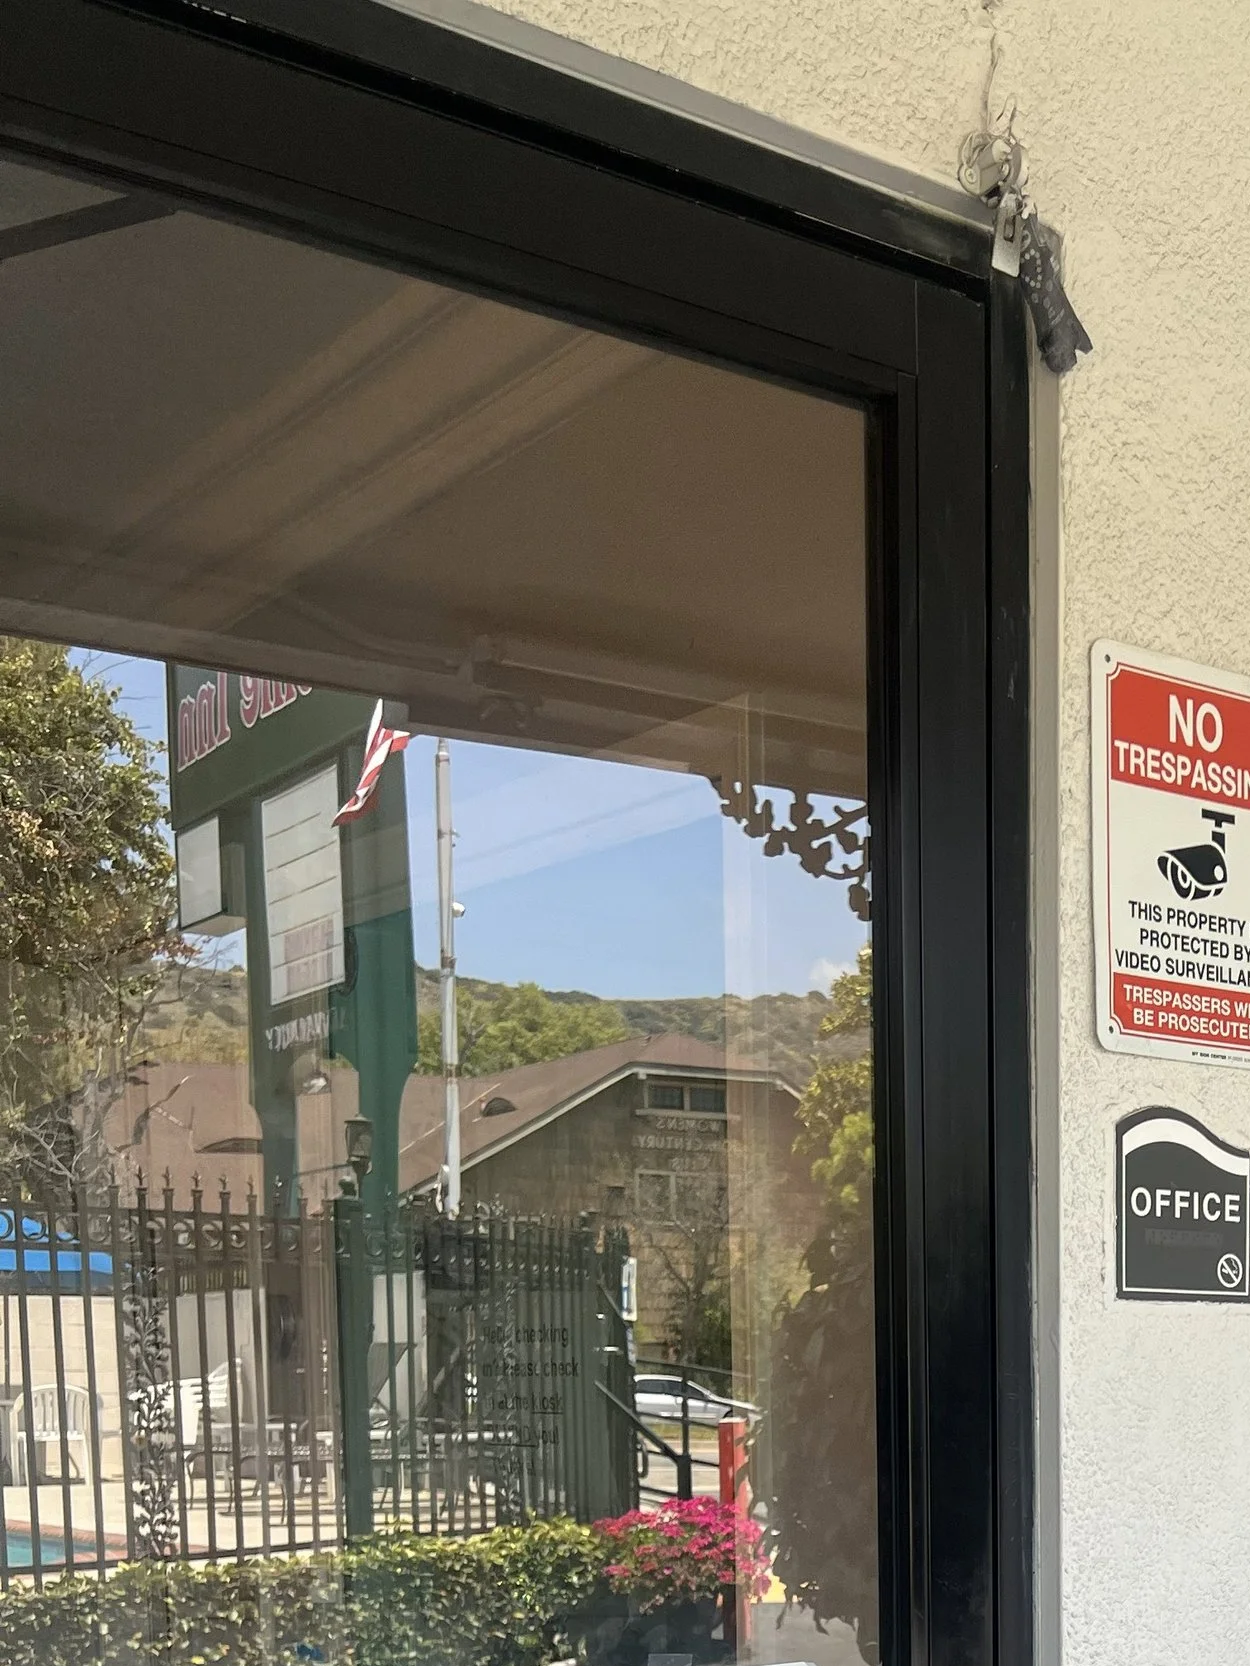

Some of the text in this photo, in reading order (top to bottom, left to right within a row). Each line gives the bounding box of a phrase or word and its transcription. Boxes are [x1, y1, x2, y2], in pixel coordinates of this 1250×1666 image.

[1169, 694, 1223, 753] NO
[1128, 900, 1163, 923] THIS
[1167, 906, 1245, 938] PROPERTY
[1115, 949, 1161, 973] VIDEO
[1140, 930, 1230, 960] PROTECTED
[1123, 984, 1230, 1016] TRESPASSERS
[1133, 1006, 1154, 1026] BE
[1131, 1187, 1241, 1223] OFFICE
